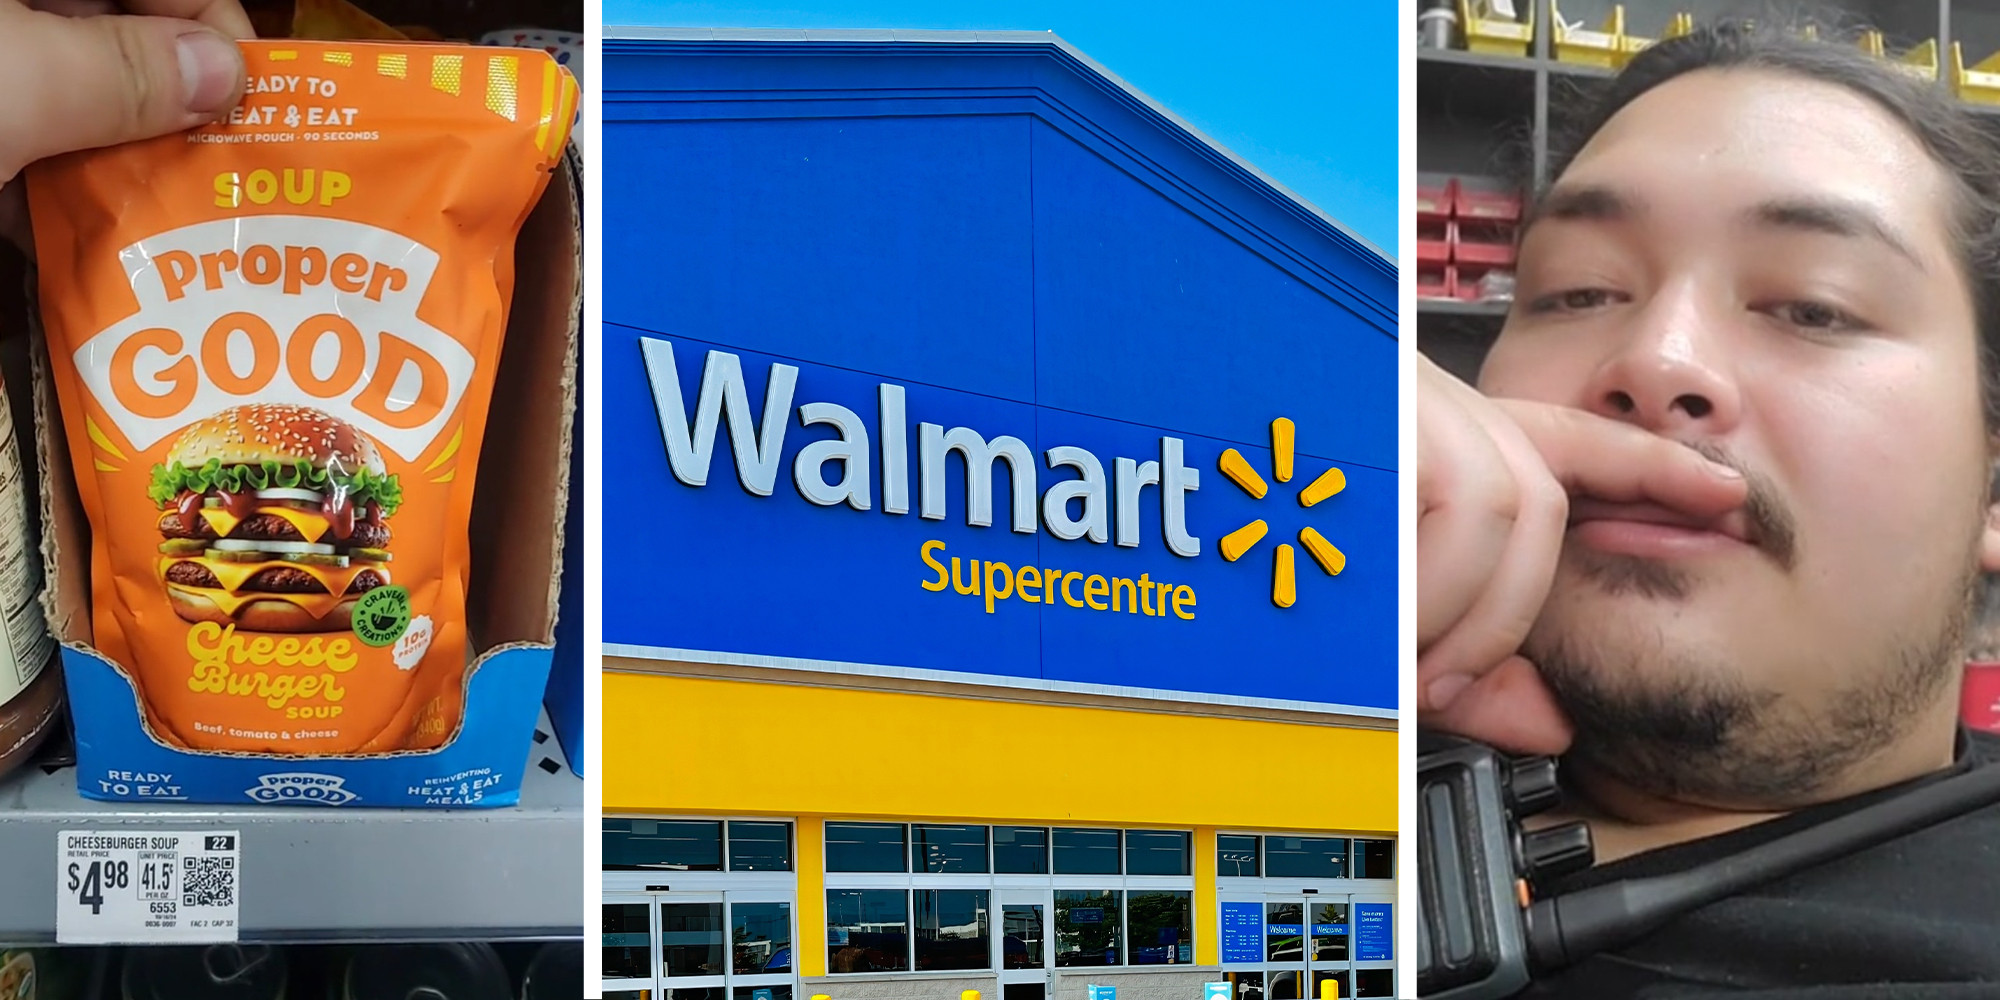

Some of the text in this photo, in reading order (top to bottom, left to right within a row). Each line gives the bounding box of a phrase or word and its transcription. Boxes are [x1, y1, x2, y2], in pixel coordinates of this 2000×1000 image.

[245, 75, 337, 98] EADY TO
[211, 104, 359, 128] EAT & EAT
[187, 133, 252, 143] MICROWAVE
[255, 132, 295, 143] POUCH
[303, 132, 320, 141] 90
[323, 131, 379, 141] SECONDS
[213, 168, 352, 208] SOUP
[152, 244, 407, 302] Proper
[109, 311, 449, 430] GOOD
[639, 335, 1201, 558] Walmart
[920, 539, 1197, 620] Supercentre
[357, 619, 403, 642] CREATIONS
[186, 620, 358, 672] Cheese
[398, 638, 428, 658] PROTEIN
[188, 660, 345, 710] Burger
[286, 706, 343, 719] SOUP
[194, 722, 339, 740] Beef, tomato & cheese
[108, 770, 173, 783] READY
[266, 775, 337, 787] Proper
[408, 774, 502, 796] HEAT & EAT
[425, 767, 491, 786] REINVENTING
[98, 780, 182, 796] TO EAT
[255, 786, 346, 802] GOOD
[425, 790, 483, 805] MEALS
[67, 836, 179, 850] CHEESEBURGER SOUP
[212, 836, 228, 850] 22
[150, 902, 177, 913] 6553
